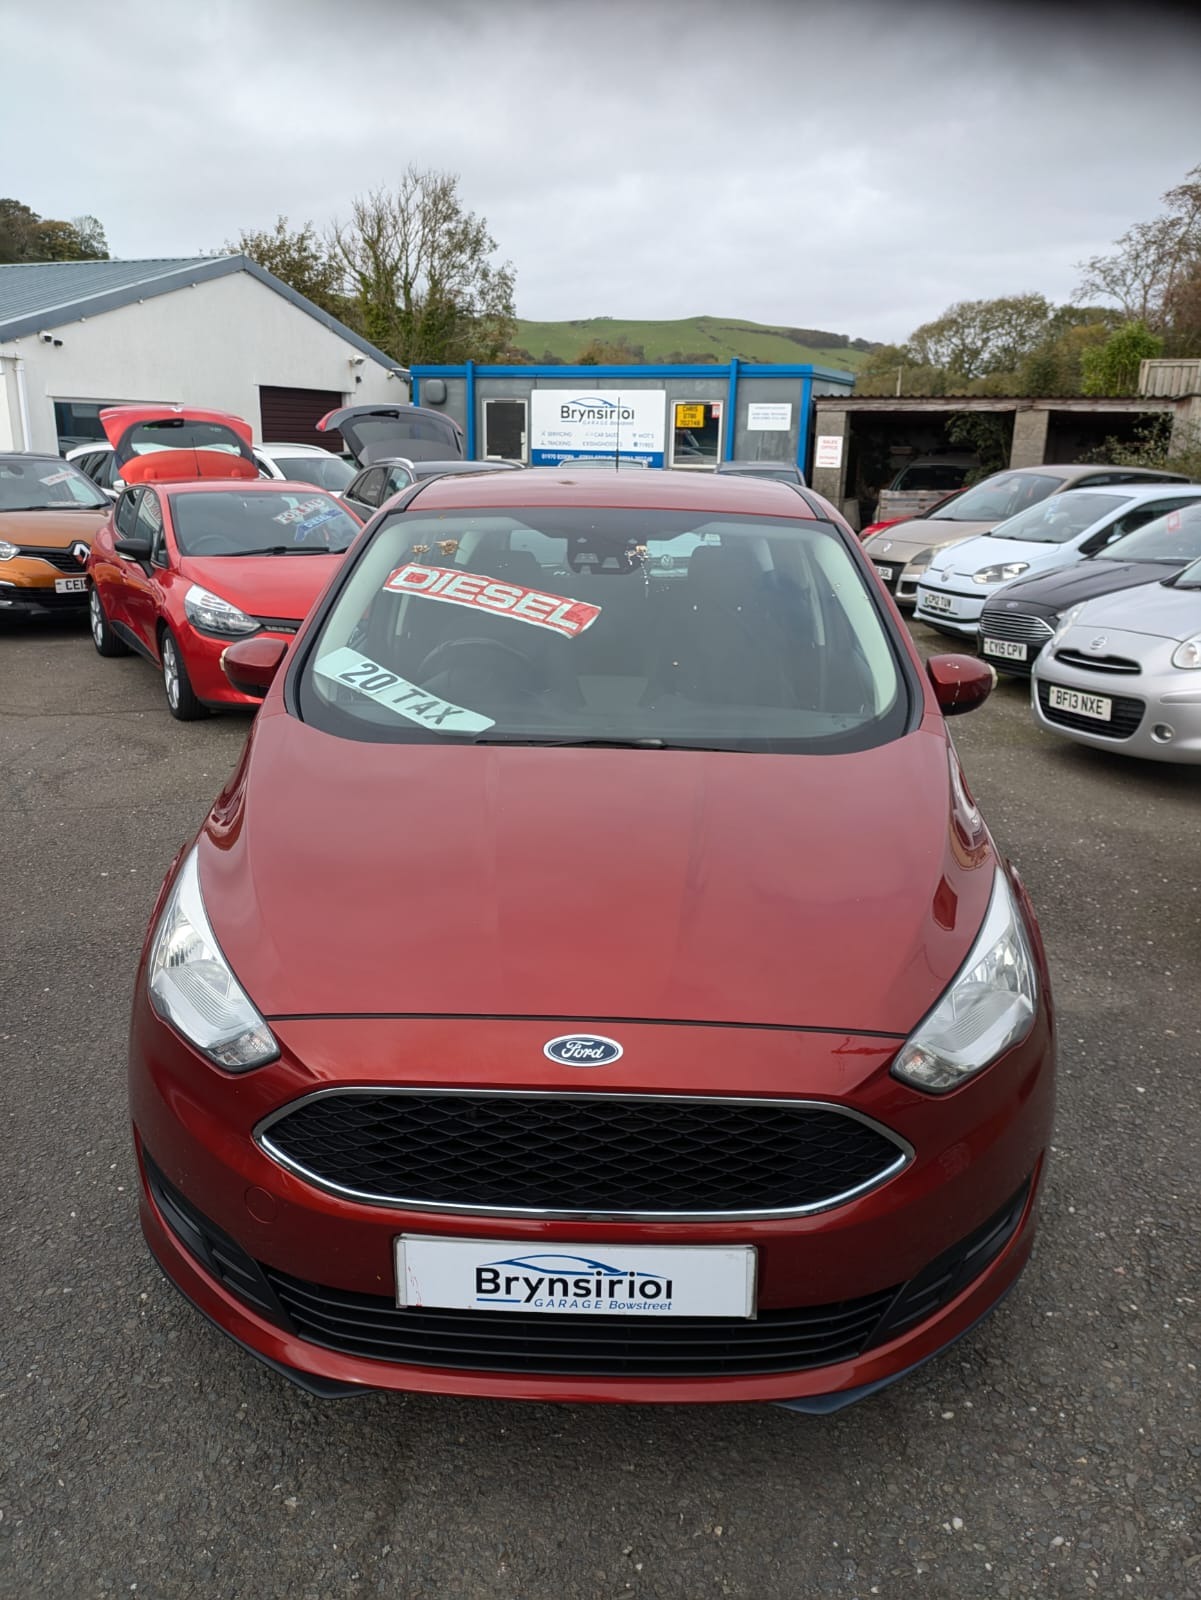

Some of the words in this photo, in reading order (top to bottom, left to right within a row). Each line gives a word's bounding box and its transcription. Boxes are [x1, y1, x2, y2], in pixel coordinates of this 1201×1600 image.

[390, 566, 579, 630] DIESEL
[989, 642, 1005, 655] CY15
[1007, 643, 1023, 657] CPV
[339, 663, 398, 692] 20
[391, 687, 465, 726] TAX
[1055, 689, 1079, 709] BF13
[1081, 695, 1104, 715] NXE
[561, 1040, 605, 1059] Ford
[475, 1267, 673, 1303] Brynsiriol
[534, 1298, 603, 1310] GARAGE
[608, 1300, 673, 1311] Bowstreet
